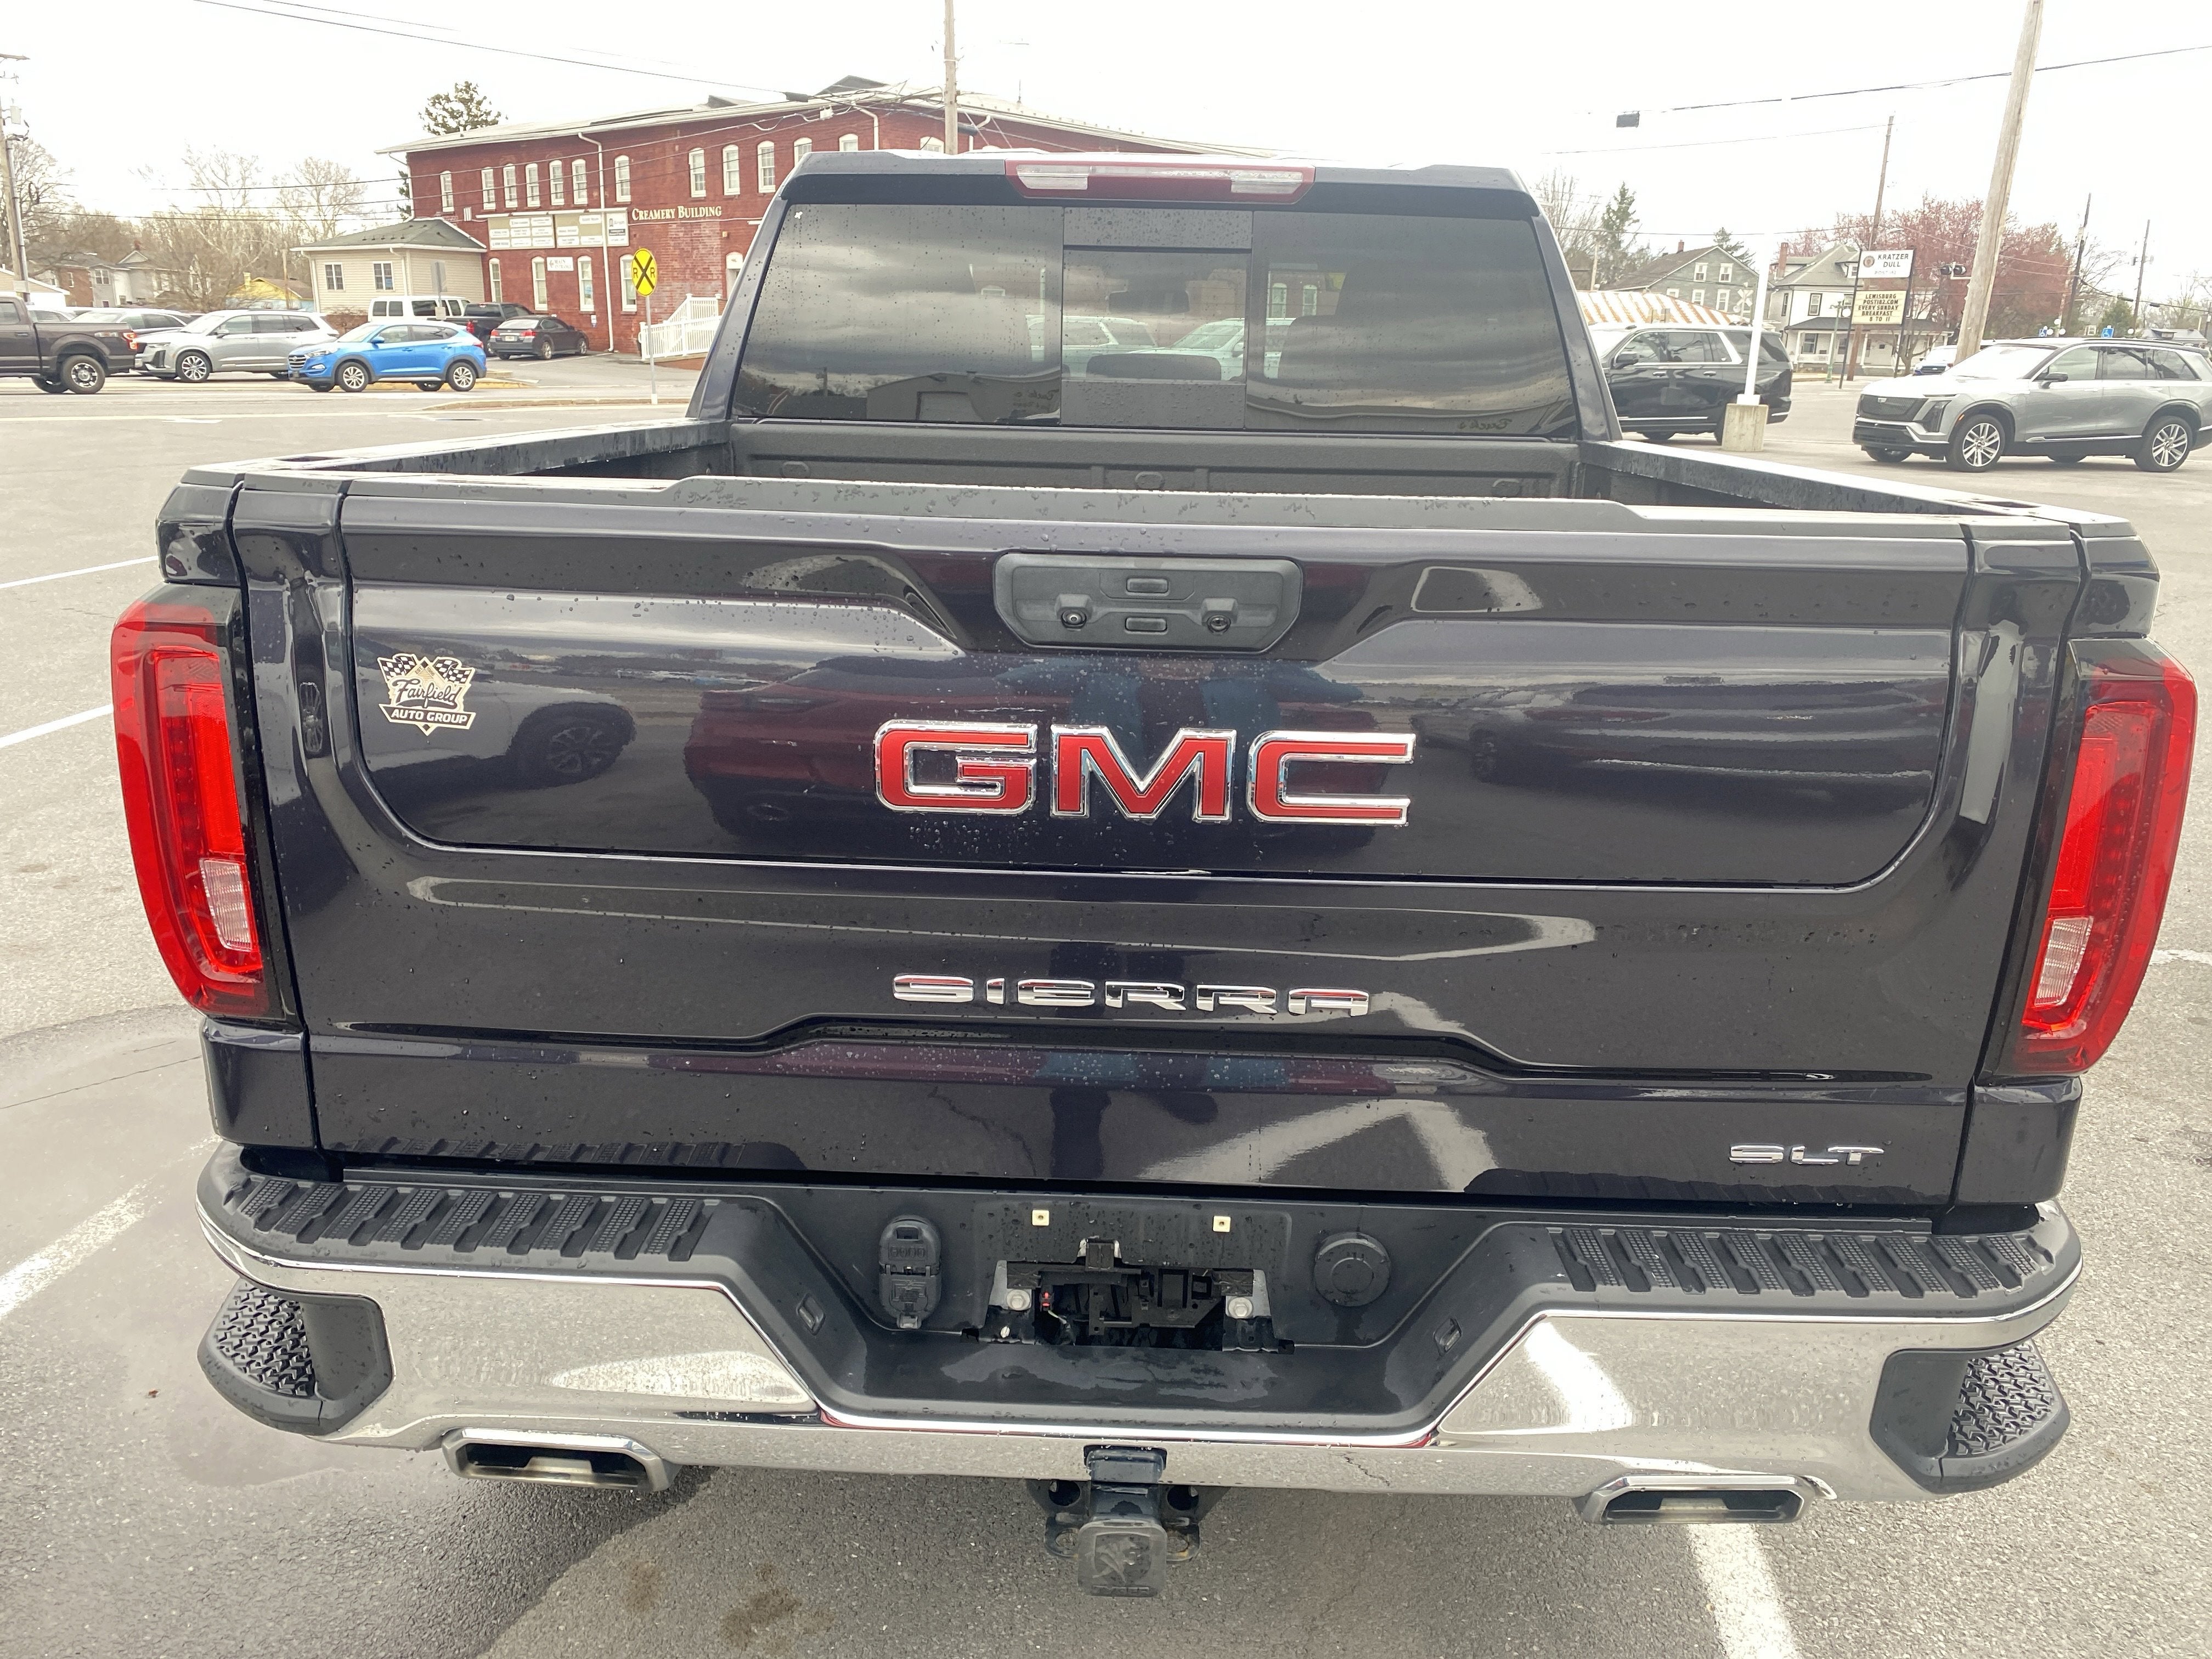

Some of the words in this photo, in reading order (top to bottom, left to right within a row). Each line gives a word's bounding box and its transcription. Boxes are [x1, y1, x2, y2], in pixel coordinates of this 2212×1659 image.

[632, 208, 675, 221] CREAMERY
[678, 206, 722, 219] BUILDING
[633, 267, 638, 279] R
[650, 267, 655, 278] R
[392, 679, 462, 707] Fairfield
[391, 709, 425, 720] AUTO
[426, 712, 467, 724] GROUP
[874, 719, 1416, 826] GMC
[893, 974, 1370, 1017] SIERRA
[1729, 1145, 1884, 1165] SLT
